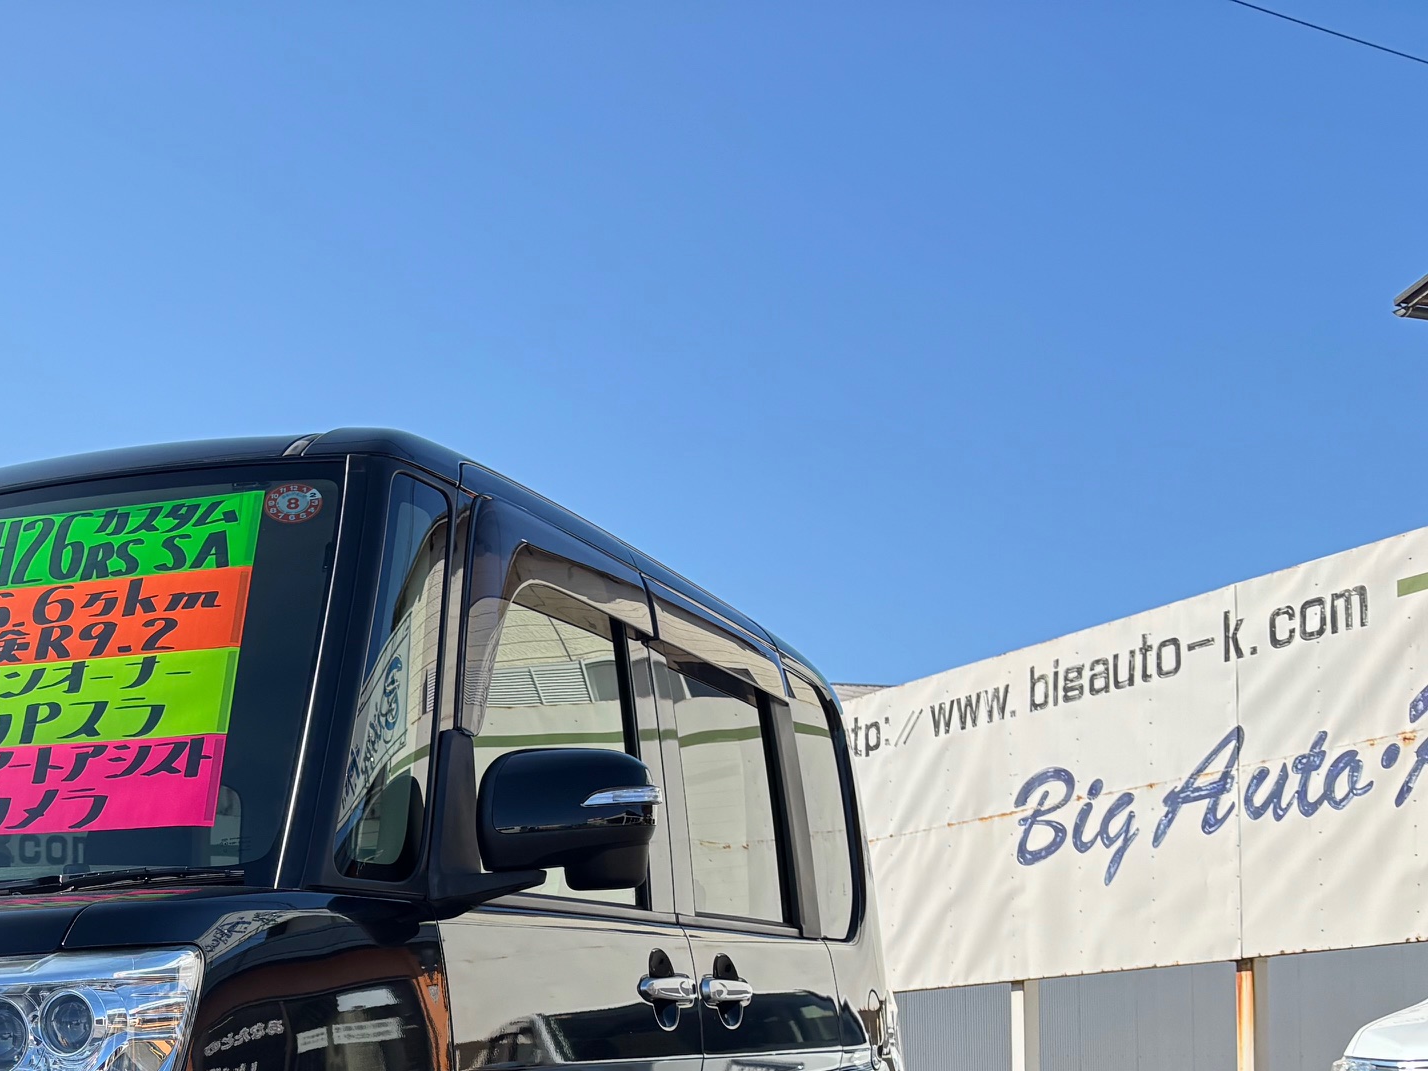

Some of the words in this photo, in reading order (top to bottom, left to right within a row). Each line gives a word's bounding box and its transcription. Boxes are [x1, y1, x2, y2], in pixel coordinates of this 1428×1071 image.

[96, 500, 240, 536] カスタム
[286, 498, 300, 510] 8
[80, 538, 142, 581] RS
[158, 531, 230, 571] SA
[1014, 765, 1139, 886] Big
